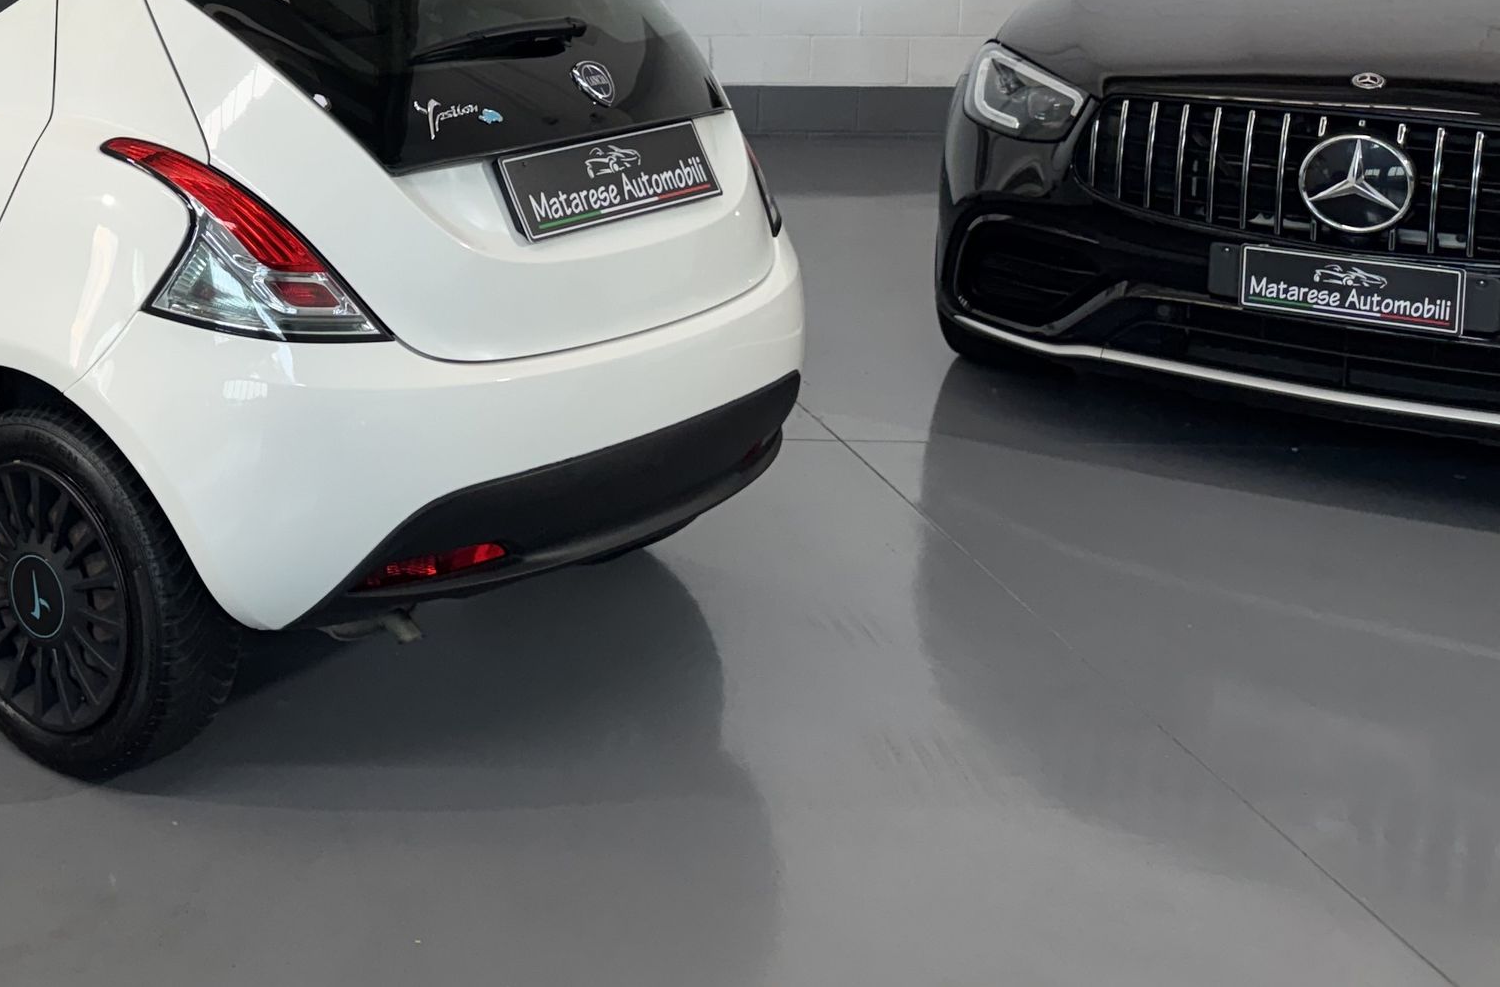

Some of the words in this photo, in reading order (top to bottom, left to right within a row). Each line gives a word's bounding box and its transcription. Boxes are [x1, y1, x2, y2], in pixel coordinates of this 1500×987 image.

[413, 98, 479, 140] Ypsilon
[528, 183, 620, 222] Matarese
[621, 156, 708, 201] Automobili
[1250, 275, 1341, 306] Matarese
[1345, 290, 1451, 321] Automobili
